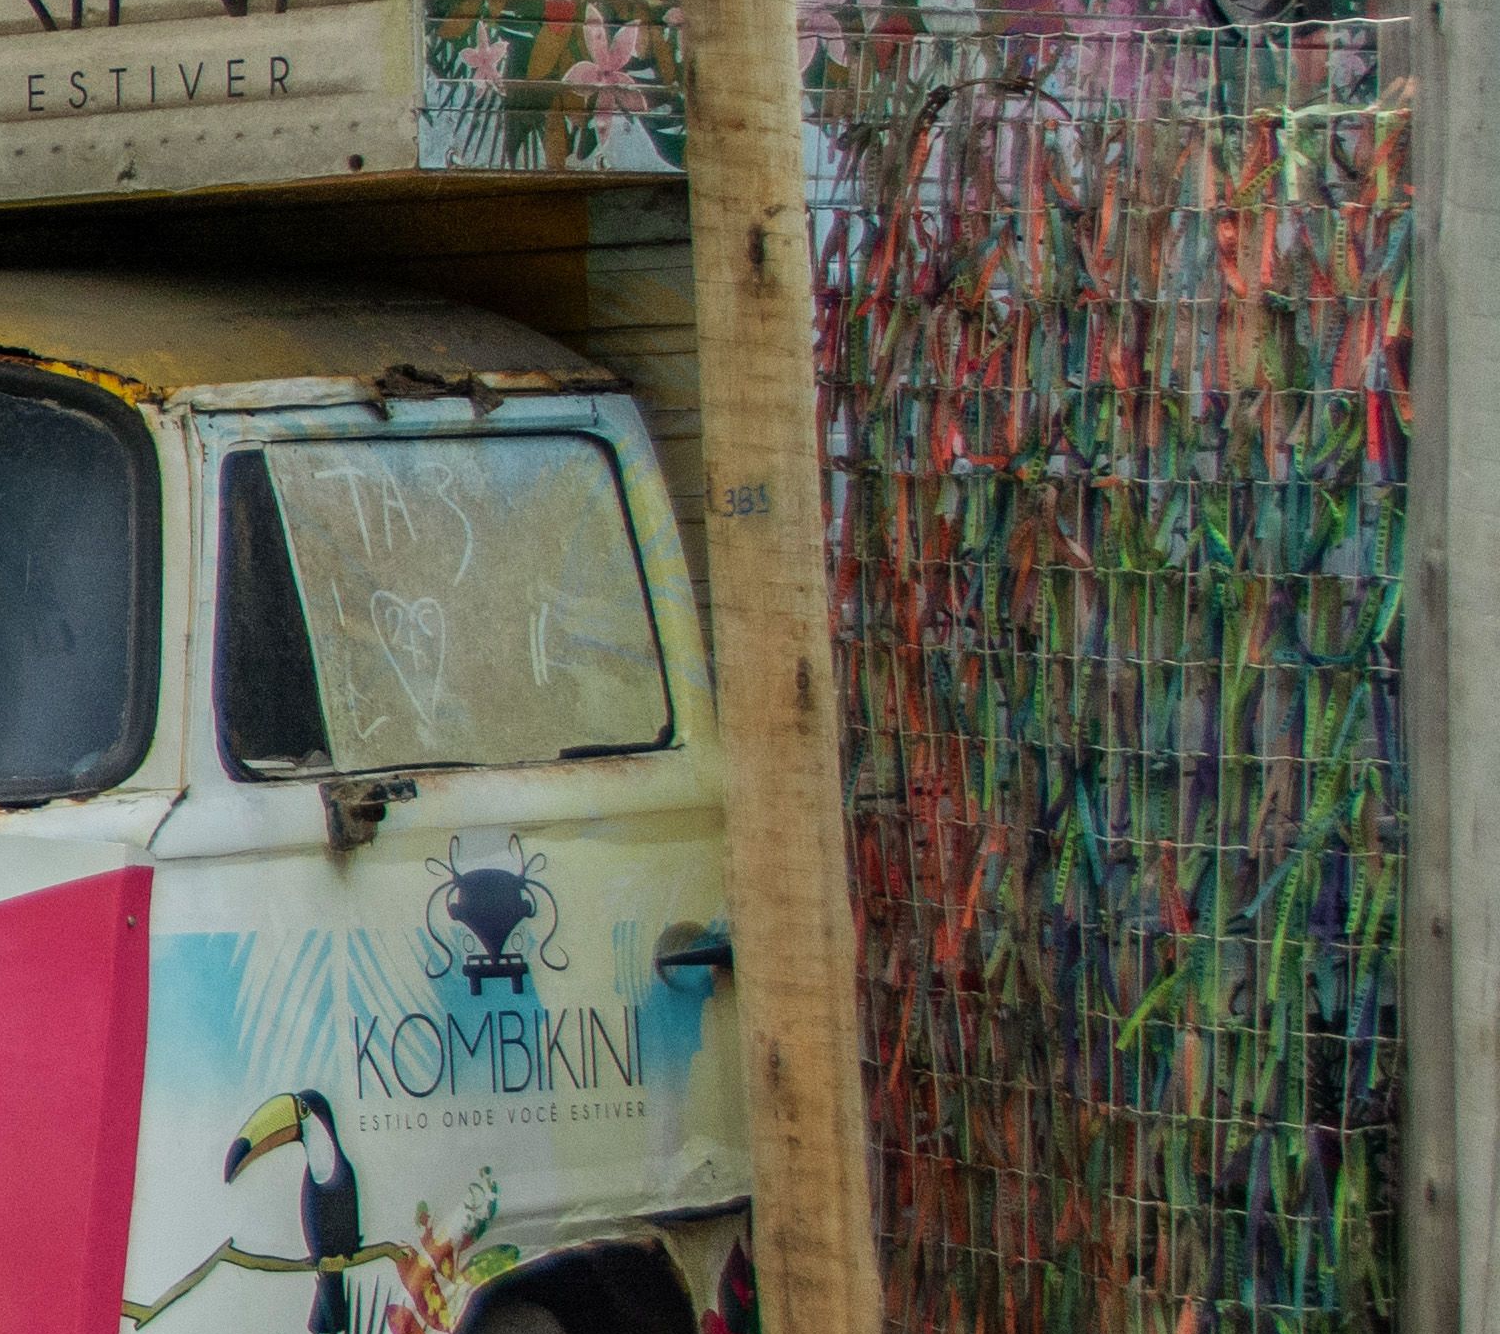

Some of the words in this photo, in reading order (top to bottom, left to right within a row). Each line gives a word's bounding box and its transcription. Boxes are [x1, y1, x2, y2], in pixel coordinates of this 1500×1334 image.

[27, 55, 293, 114] ESTIVER
[354, 1005, 643, 1099] KOMBIKINI
[359, 1113, 428, 1132] ESTILO
[443, 1108, 494, 1128] ONDE
[507, 1102, 557, 1124] VOCÊ
[570, 1101, 646, 1121] ESTIVER
